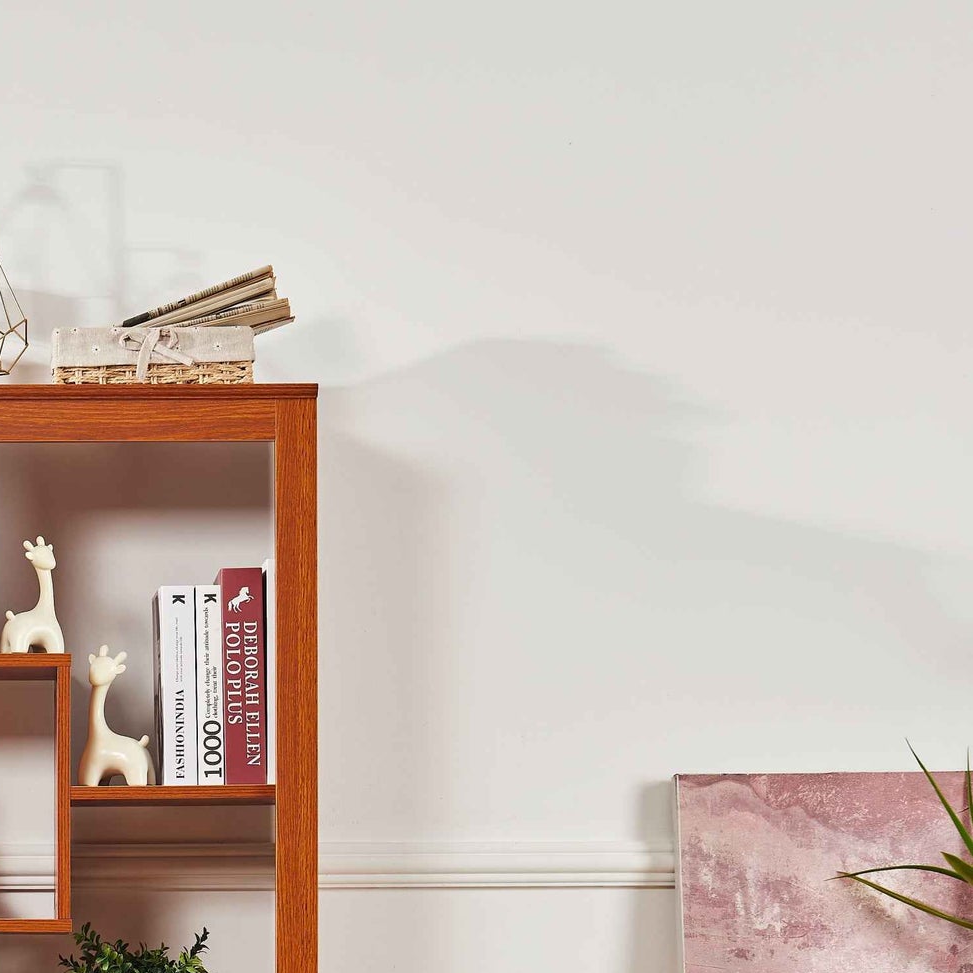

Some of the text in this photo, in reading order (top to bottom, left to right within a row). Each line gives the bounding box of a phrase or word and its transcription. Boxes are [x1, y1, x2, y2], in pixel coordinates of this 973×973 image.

[172, 594, 185, 605] K
[204, 593, 217, 604] K
[225, 622, 243, 725] POLO PLUS
[243, 621, 261, 766] DEBORAH ELLEN
[204, 688, 212, 719] Completely
[174, 689, 185, 779] FASHIONINDIA
[202, 720, 222, 778] 1000
